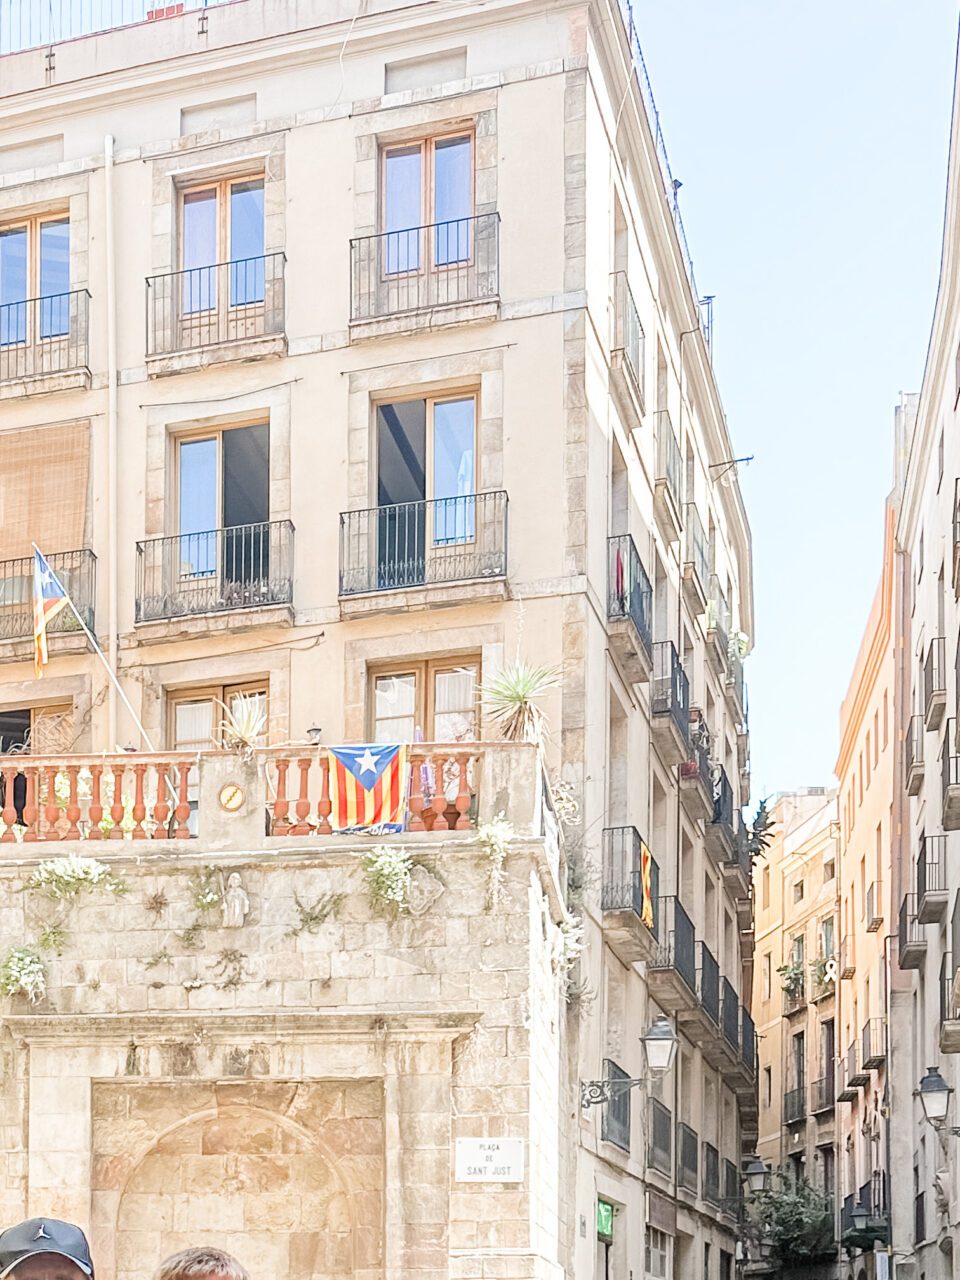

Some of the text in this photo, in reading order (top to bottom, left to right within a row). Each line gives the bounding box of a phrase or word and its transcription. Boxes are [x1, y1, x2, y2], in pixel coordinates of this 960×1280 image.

[479, 1144, 500, 1152] PLAÇA
[466, 1166, 512, 1176] SANT JUST
